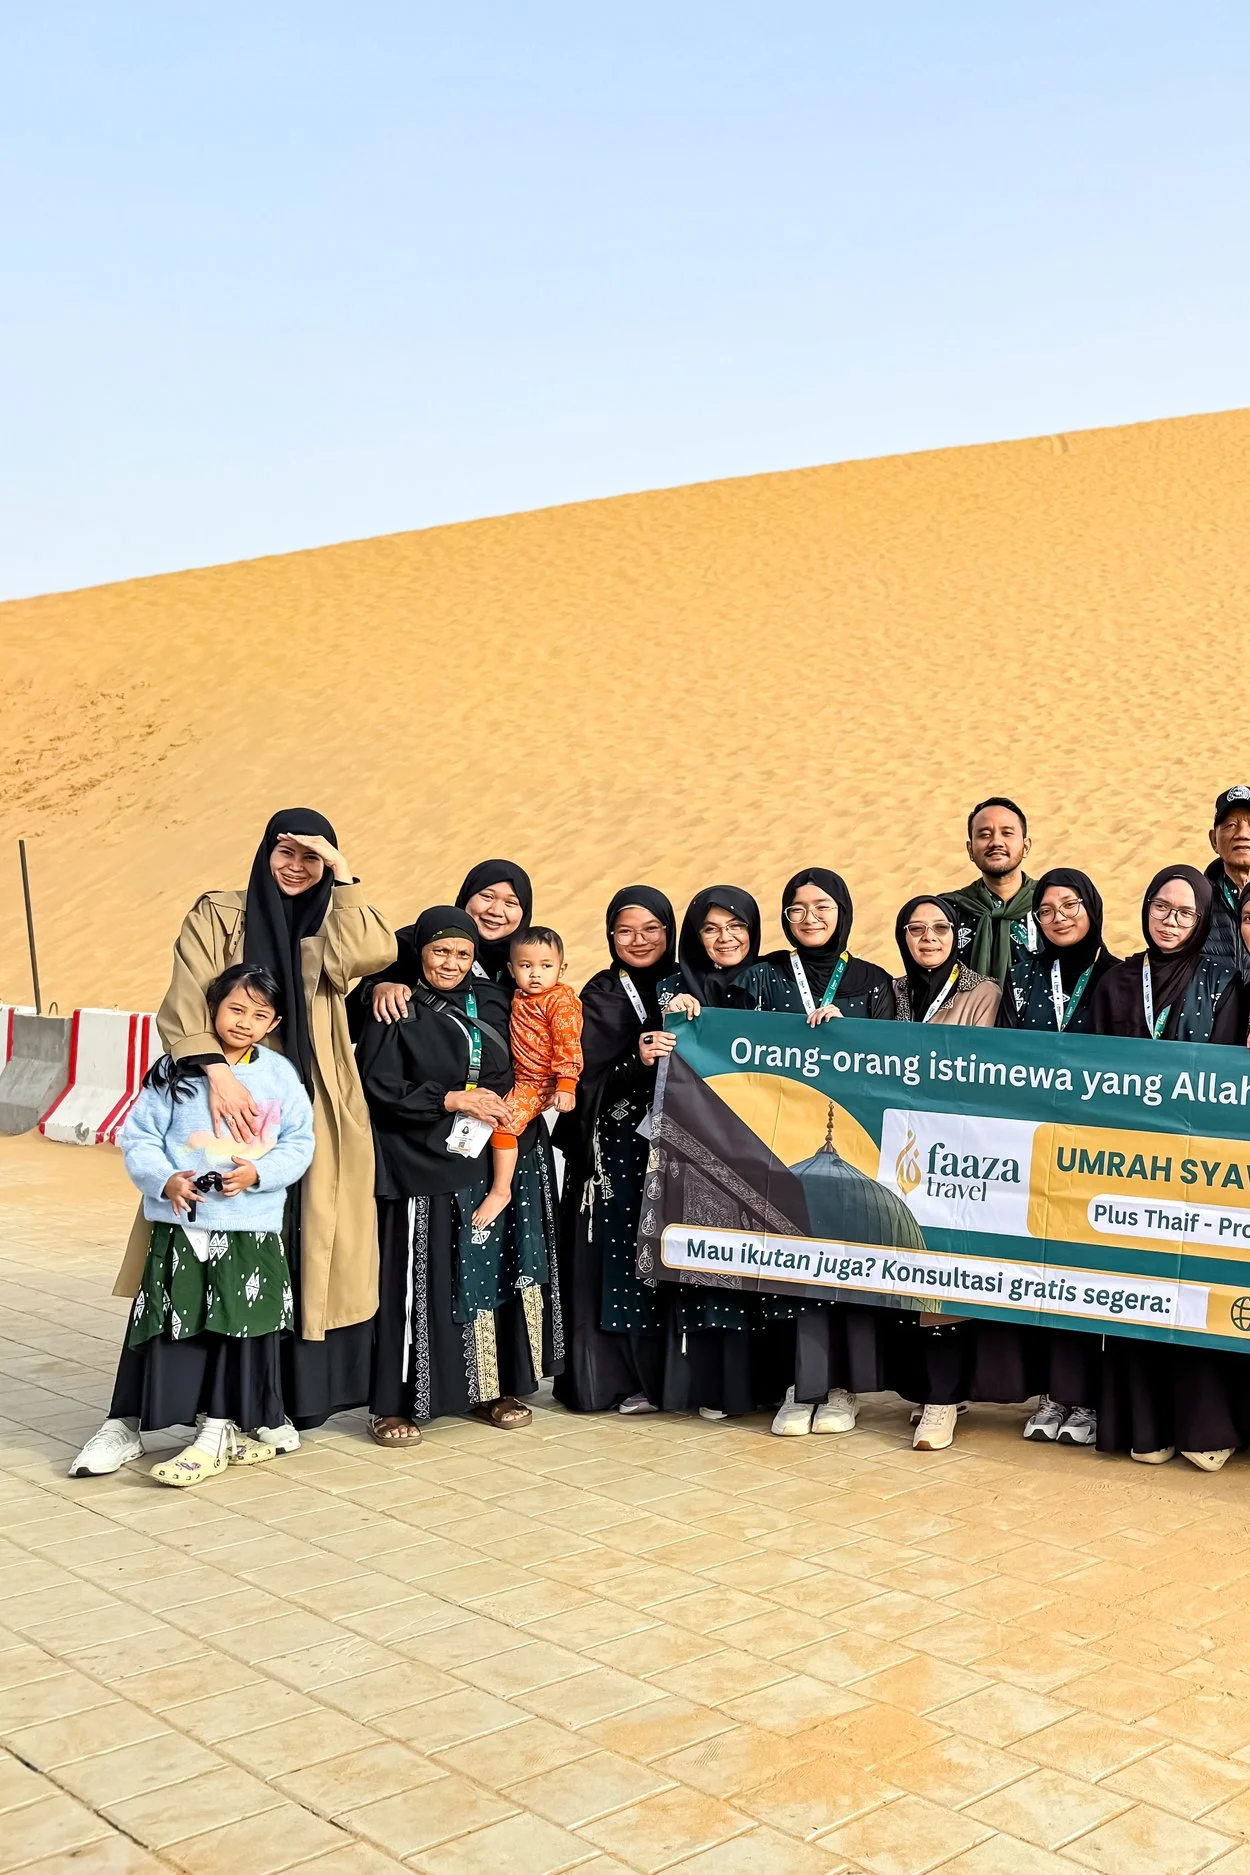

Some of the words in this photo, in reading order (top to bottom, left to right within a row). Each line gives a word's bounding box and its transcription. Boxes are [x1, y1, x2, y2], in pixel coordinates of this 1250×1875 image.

[731, 1038, 920, 1085] Orang-orang
[930, 1051, 1073, 1090] istimewa
[1081, 1071, 1162, 1105] yang
[927, 1143, 1020, 1183] faaza
[1057, 1147, 1172, 1182] UMRAH
[927, 1177, 986, 1201] travel
[1095, 1205, 1137, 1226] Plus
[1145, 1210, 1199, 1232] Thaif
[688, 1239, 733, 1261] Mau
[741, 1243, 810, 1270] ikutan
[813, 1251, 876, 1280] juga?
[882, 1260, 1003, 1293] Konsultasi
[1009, 1278, 1076, 1301] gratis
[1083, 1288, 1171, 1313] segera:
